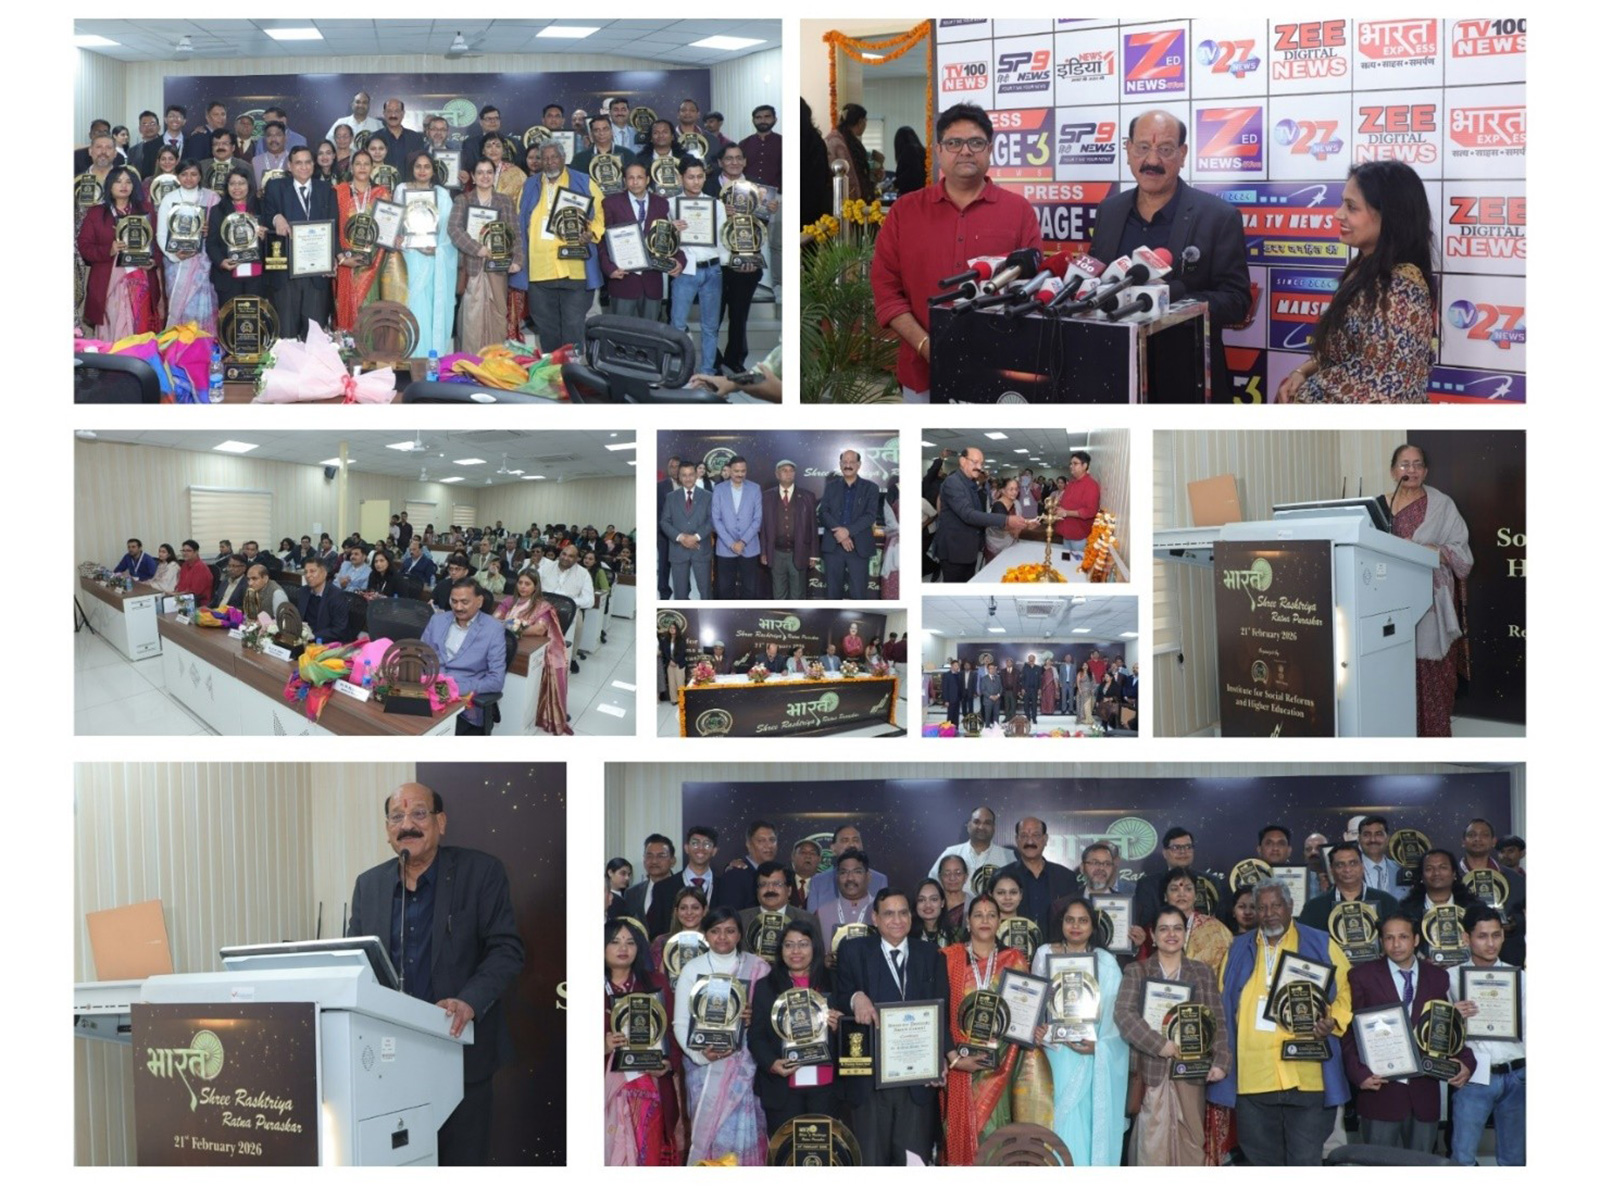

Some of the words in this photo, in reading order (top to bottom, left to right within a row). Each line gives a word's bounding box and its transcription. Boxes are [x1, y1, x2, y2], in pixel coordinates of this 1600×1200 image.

[1274, 19, 1346, 51] ZEE
[1360, 22, 1432, 56] भारत
[1079, 51, 1103, 60] NEWS
[1284, 48, 1337, 60] DIGITAL
[1383, 44, 1436, 56] EXPESS
[997, 50, 1050, 73] SP9
[1056, 57, 1102, 78] इंडिया
[1272, 57, 1347, 80] NEWS
[944, 76, 986, 91] NEWS
[1017, 71, 1050, 82] NEWS
[1126, 79, 1166, 92] NEWS
[1358, 104, 1436, 133] ZEE
[1058, 122, 1116, 143] SP9
[1368, 133, 1427, 144] DIGITAL
[1080, 143, 1116, 153] NEWS
[1356, 143, 1437, 164] NEWS
[1198, 157, 1242, 169] NEWS
[1024, 185, 1083, 200] PRESS
[1449, 196, 1526, 226] ZEE
[1266, 214, 1284, 228] TV
[1289, 214, 1334, 229] NEWS
[1460, 225, 1525, 237] DIGITAL
[1494, 331, 1525, 342] NEWS
[1497, 527, 1526, 547] So
[1507, 558, 1526, 577] H
[1223, 570, 1263, 612] भारत
[1257, 595, 1277, 609] Shree
[1279, 596, 1317, 614] Rashtriya
[1252, 627, 1280, 641] February
[1282, 631, 1298, 641] 2026
[1226, 683, 1253, 696] Institute
[1253, 687, 1264, 697] for
[1264, 690, 1284, 701] Social
[1285, 692, 1315, 707] Reforms
[787, 700, 830, 727] भारत
[1235, 698, 1248, 707] and
[1271, 703, 1305, 718] Education
[146, 1047, 209, 1112] भारत
[200, 1086, 231, 1106] Shree
[234, 1088, 294, 1114] Rashtriya
[222, 1111, 252, 1128] Ratna
[254, 1113, 303, 1133] Puraskar
[191, 1136, 236, 1157] February
[237, 1141, 263, 1156] 2026
